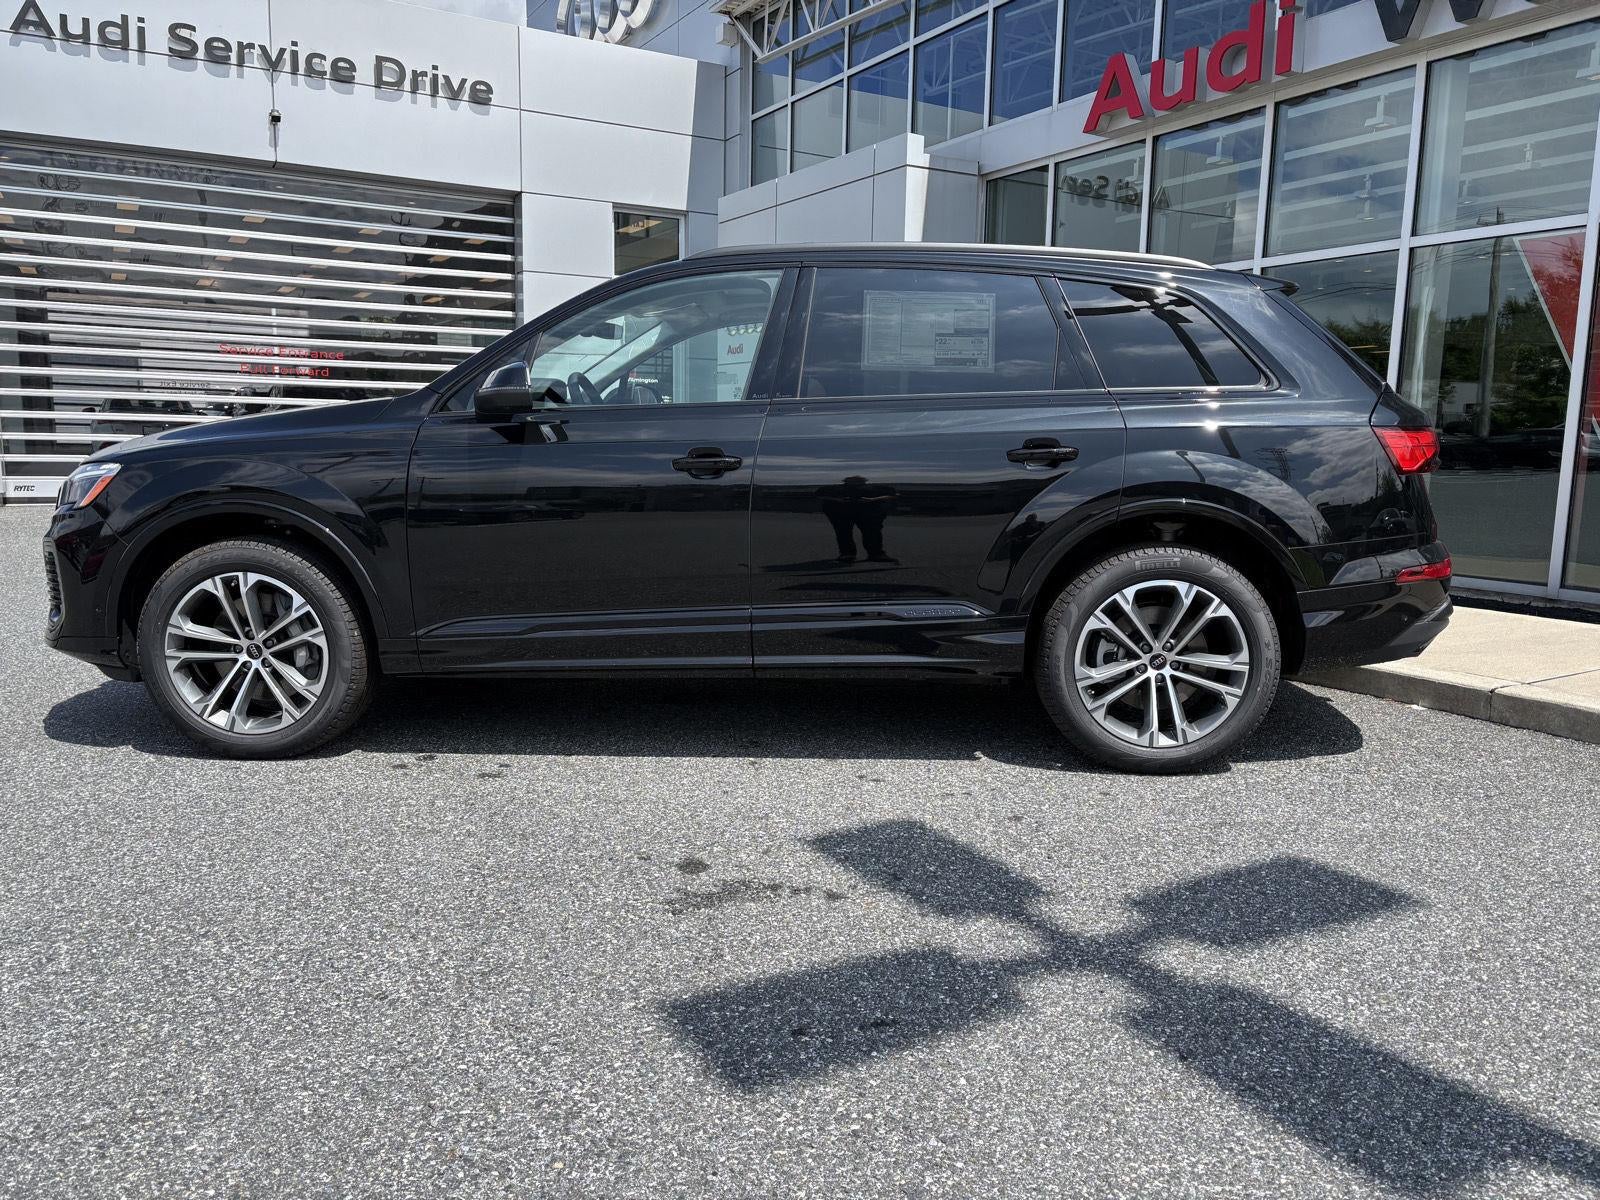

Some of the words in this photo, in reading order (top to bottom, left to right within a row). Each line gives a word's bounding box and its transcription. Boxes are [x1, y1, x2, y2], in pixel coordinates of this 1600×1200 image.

[10, 0, 147, 53] Audi
[168, 22, 357, 83] Service
[375, 55, 494, 105] Drive
[1083, 0, 1296, 134] Audi
[217, 342, 274, 357] Service
[278, 345, 345, 361] Entrance
[727, 343, 744, 356] Audi
[239, 362, 268, 375] Pull
[272, 364, 330, 378] Forward
